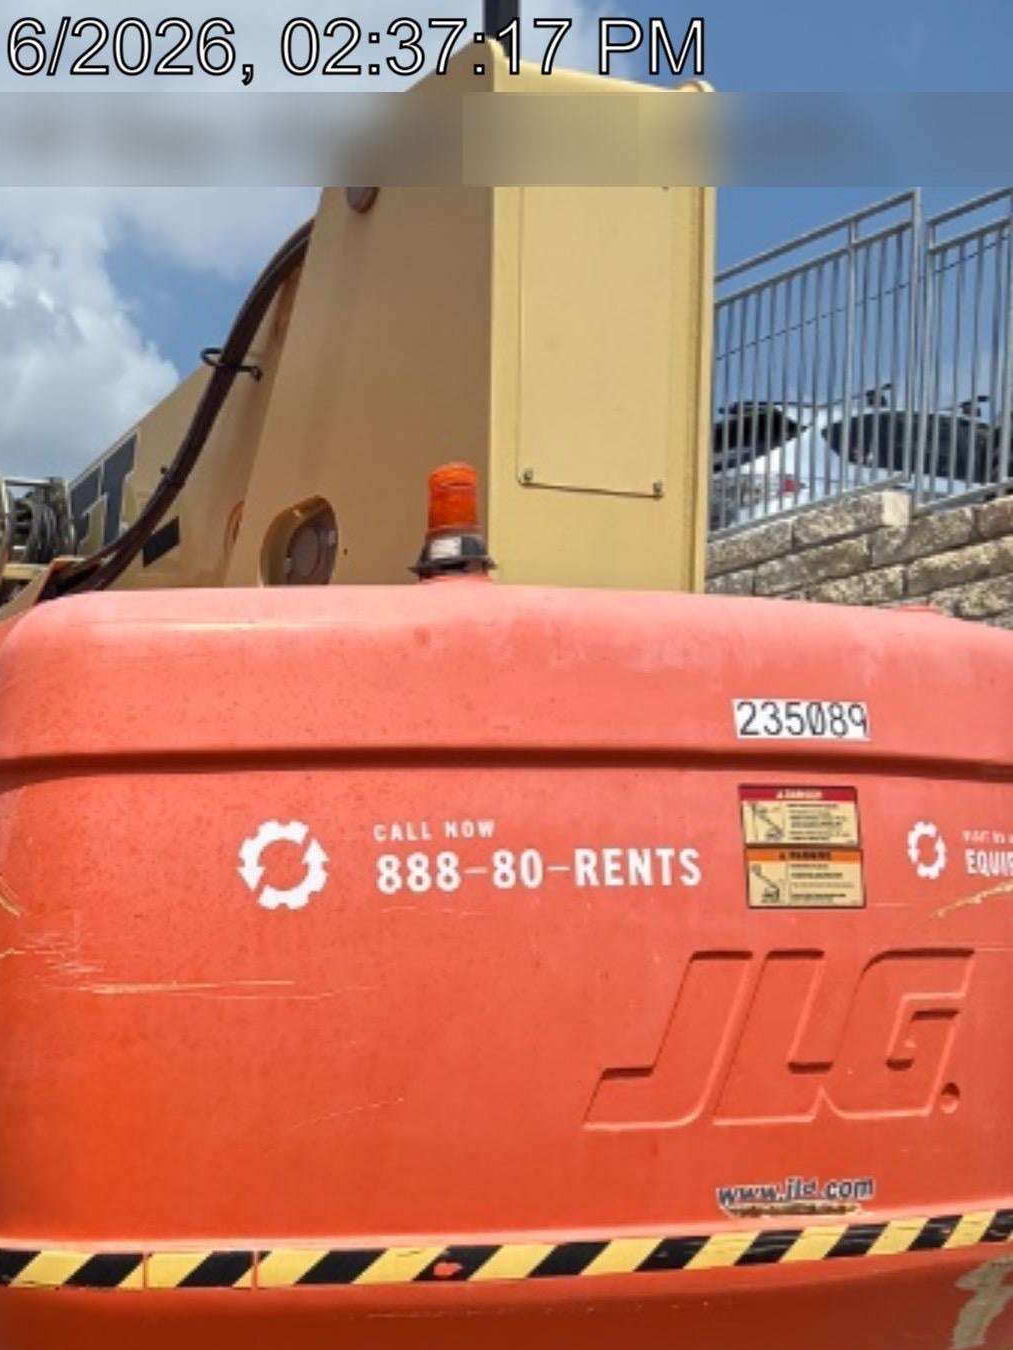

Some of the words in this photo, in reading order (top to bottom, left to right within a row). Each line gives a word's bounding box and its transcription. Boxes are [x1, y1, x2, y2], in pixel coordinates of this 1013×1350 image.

[737, 701, 868, 737] 235089
[373, 820, 433, 842] CALL
[445, 819, 496, 839] NOW
[376, 847, 702, 894] 888-80-RENTS
